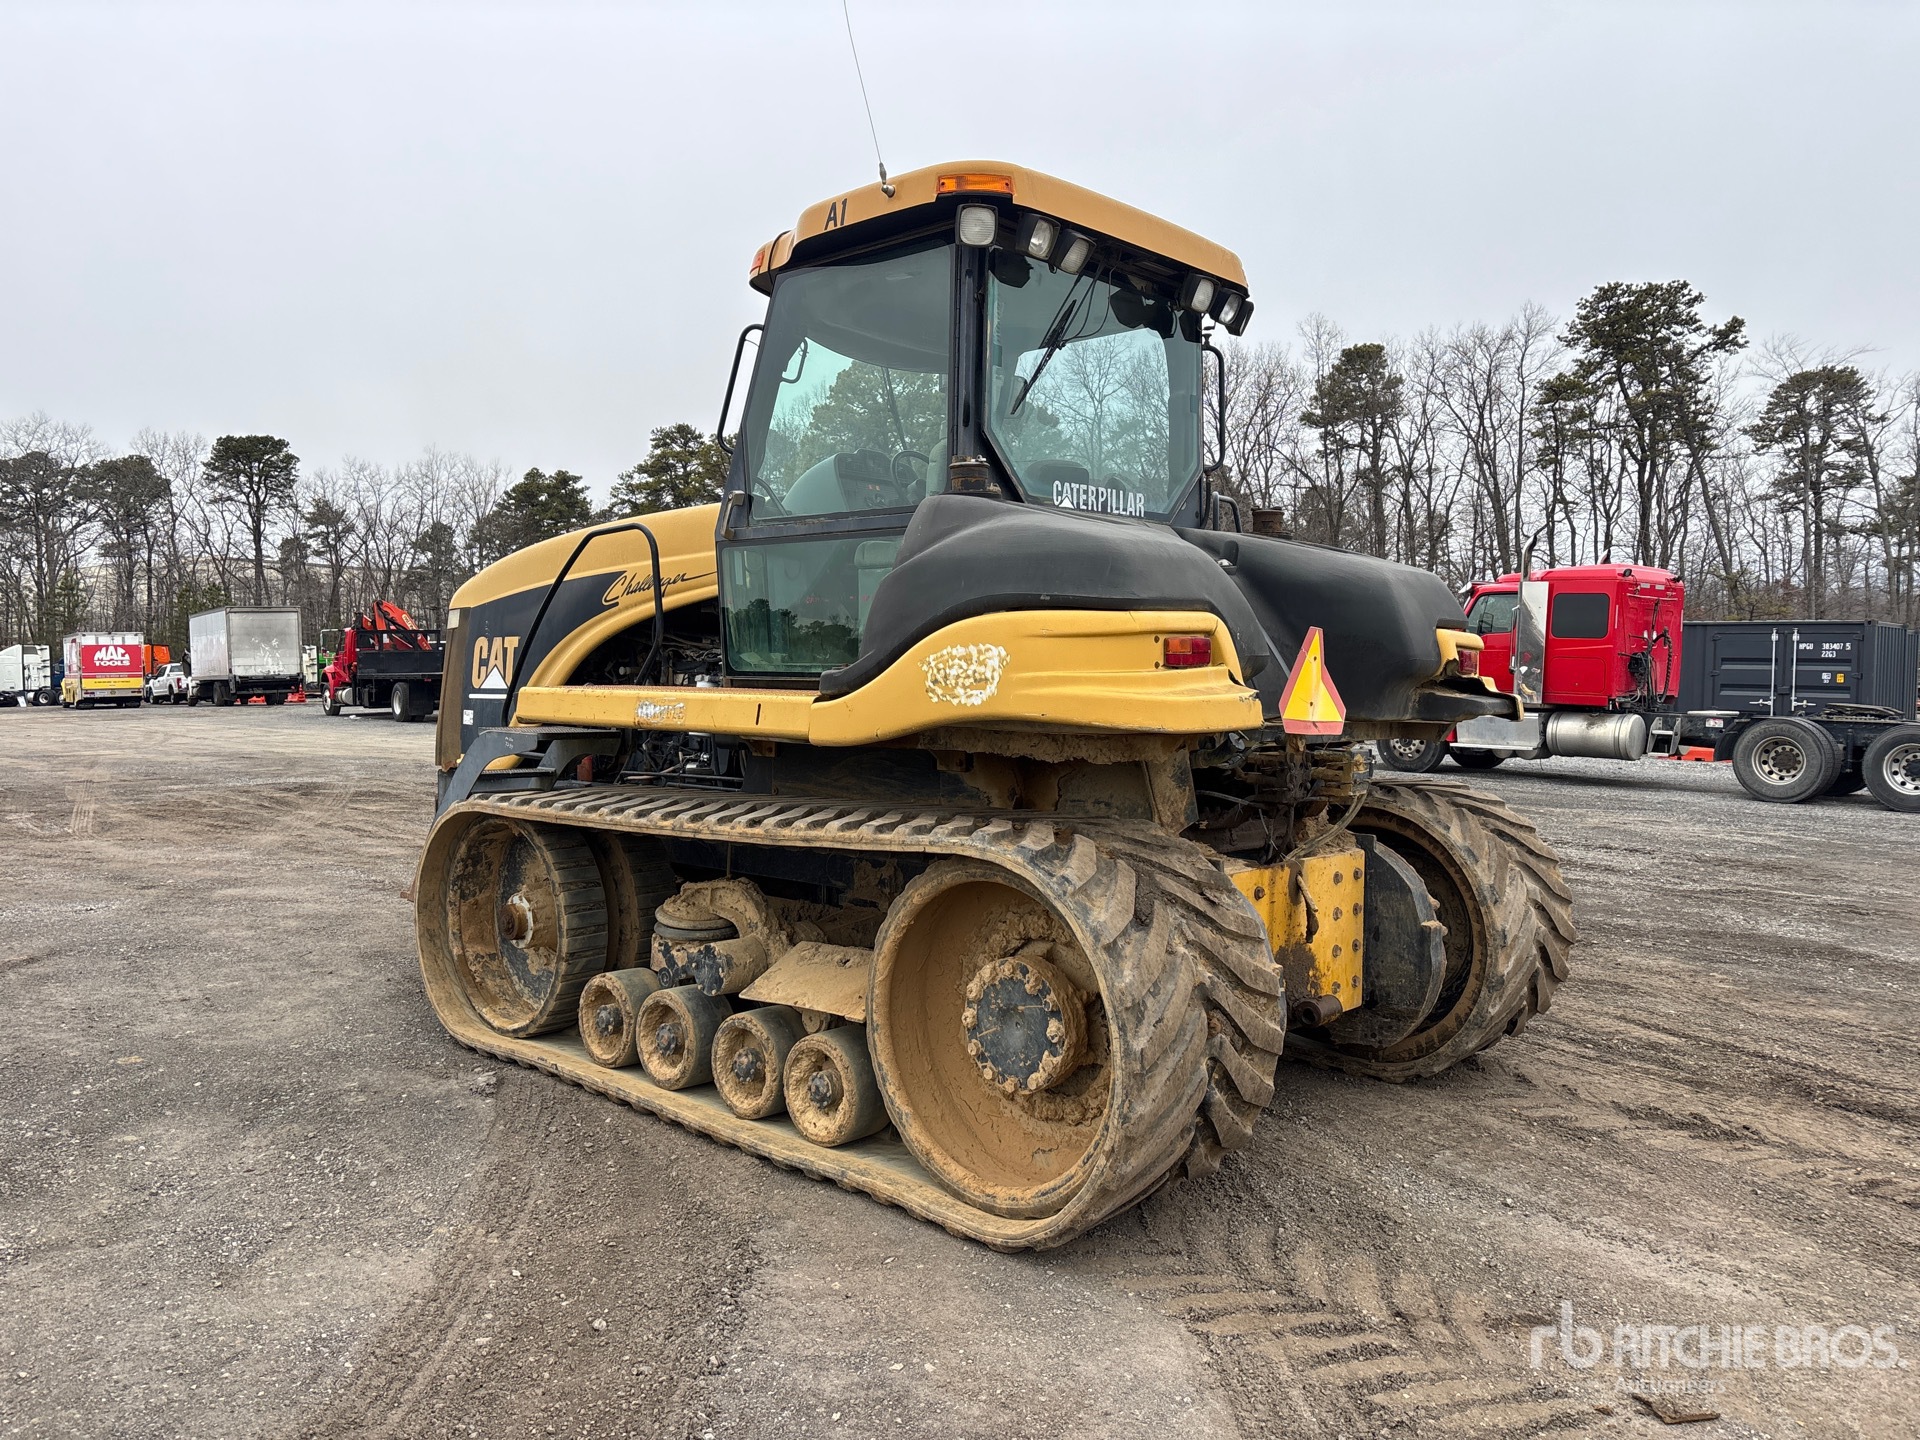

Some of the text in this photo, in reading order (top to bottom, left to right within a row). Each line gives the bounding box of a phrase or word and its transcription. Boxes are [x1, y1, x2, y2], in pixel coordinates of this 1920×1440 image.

[824, 198, 848, 231] A1
[1052, 480, 1145, 518] CATERPILLAR
[602, 572, 717, 602] Challeger
[94, 645, 130, 660] MAC
[1845, 642, 1852, 651] 5
[472, 636, 521, 689] CAT
